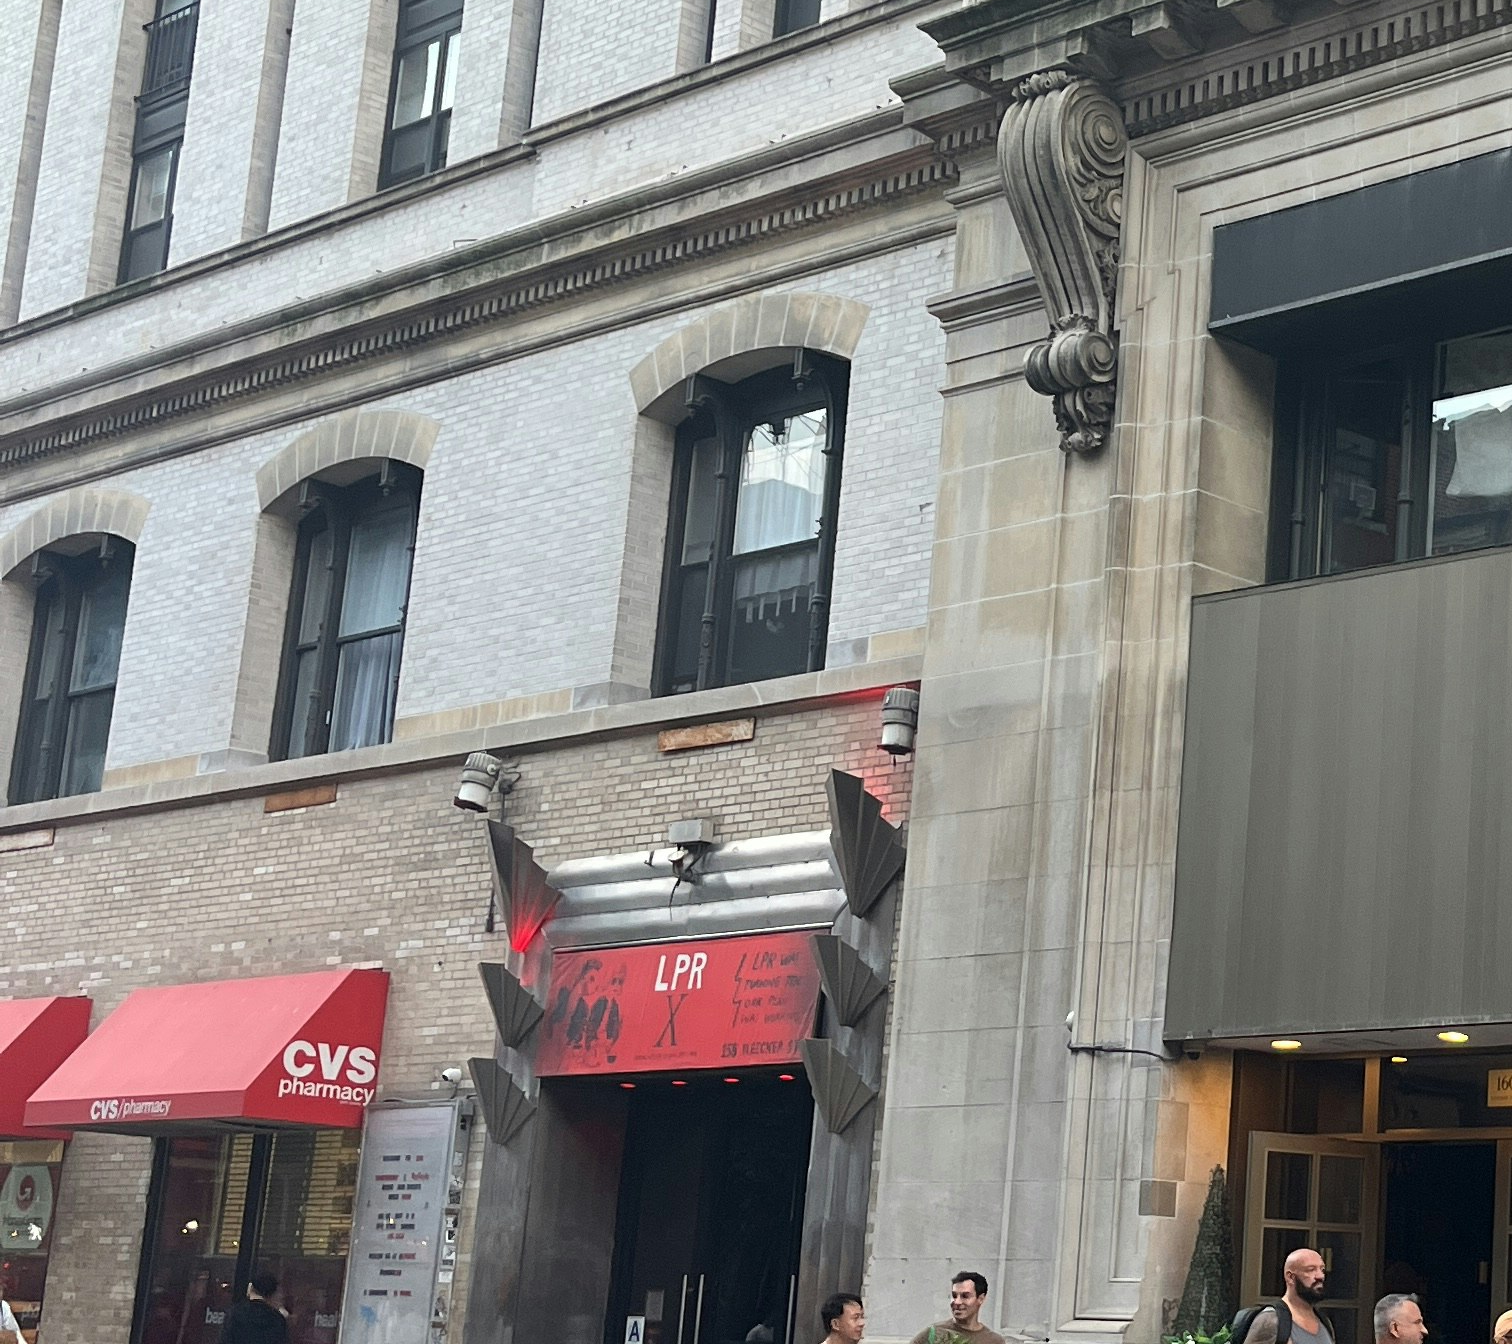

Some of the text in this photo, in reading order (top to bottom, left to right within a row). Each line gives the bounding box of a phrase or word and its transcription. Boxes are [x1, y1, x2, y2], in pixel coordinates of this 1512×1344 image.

[654, 952, 708, 992] LPR
[653, 993, 689, 1047] X
[282, 1040, 376, 1084] CVS
[278, 1076, 375, 1107] pharmacy
[205, 1307, 225, 1324] bea
[628, 1320, 640, 1341] A
